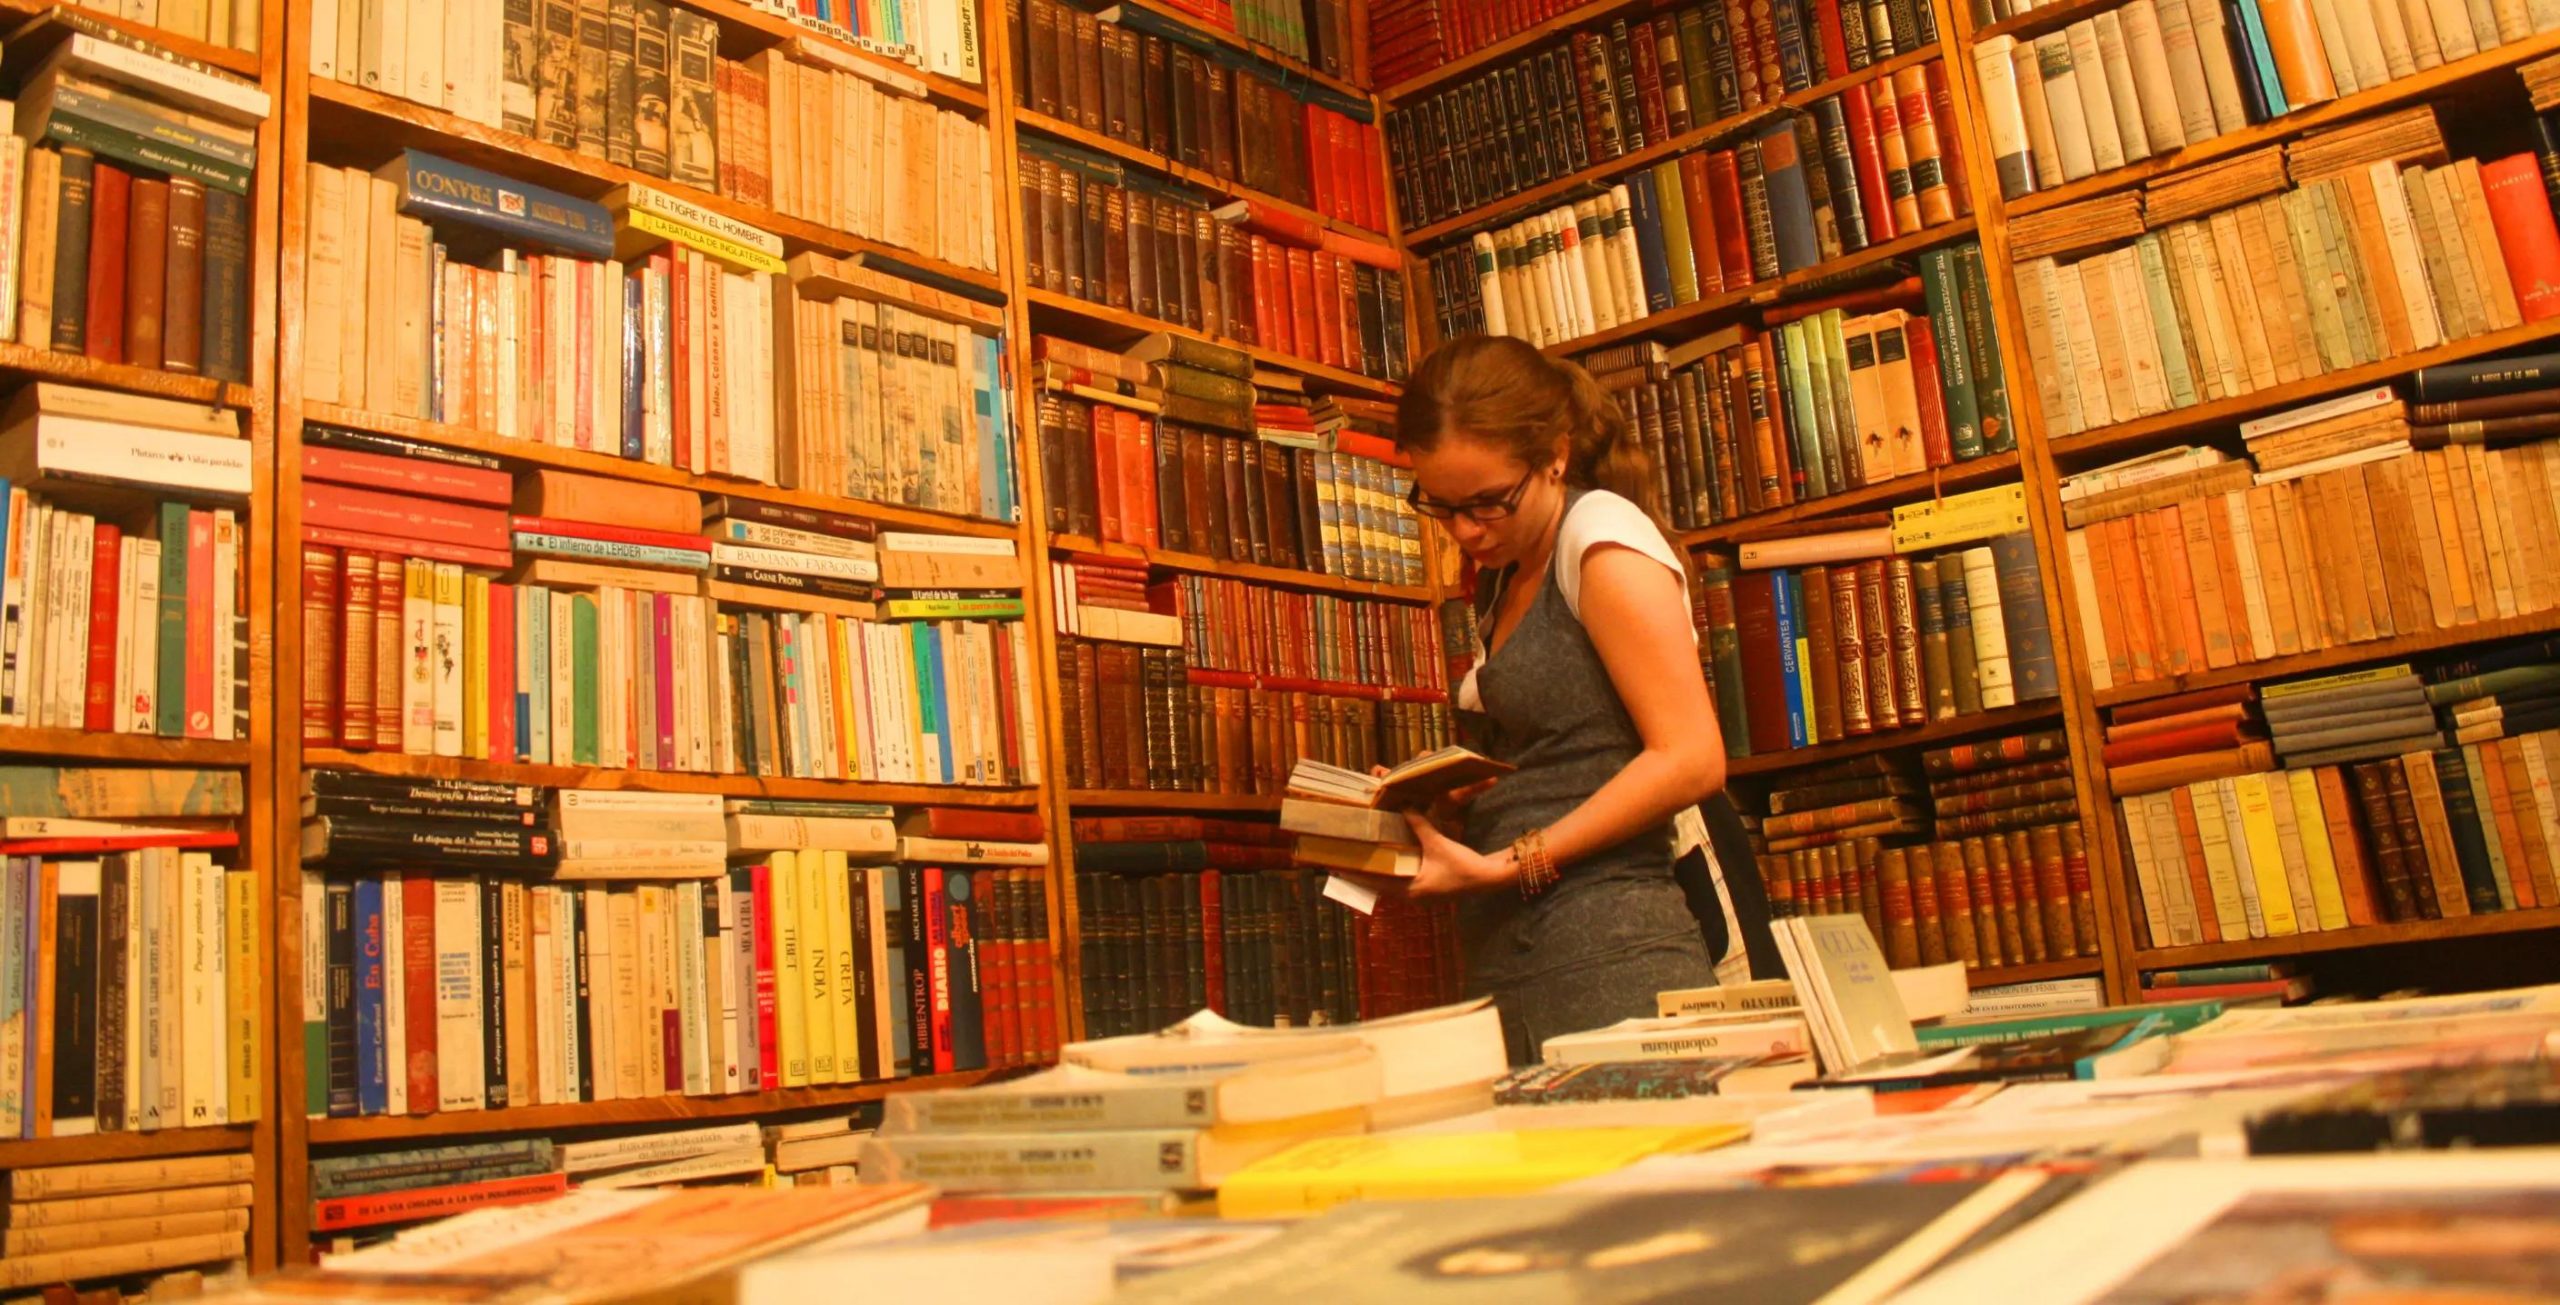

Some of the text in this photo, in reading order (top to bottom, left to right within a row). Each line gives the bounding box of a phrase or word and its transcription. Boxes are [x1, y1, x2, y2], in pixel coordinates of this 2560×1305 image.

[963, 7, 976, 67] EL COMPLOT
[416, 169, 495, 210] FRANCO
[655, 195, 764, 246] EL TIGRE Y EL HOMBRE
[655, 220, 772, 268] LA BATALLA DE INGLATERRA
[559, 539, 590, 553] infierno
[592, 541, 604, 553] de
[606, 543, 641, 558] LEHDER
[737, 549, 799, 569] BAUMANN
[1780, 619, 1795, 673] CERVANTES
[410, 788, 464, 802] Demografía
[413, 834, 422, 843] La
[454, 836, 466, 845] del
[494, 838, 520, 847] Mundo
[739, 899, 751, 928] CUBA
[911, 897, 921, 941] MICHAEL
[364, 913, 380, 958] Cuba
[740, 930, 752, 953] MEA
[1820, 930, 1871, 955] CELA
[365, 964, 380, 989] En
[812, 949, 826, 1000] INDIA
[840, 950, 853, 1007] CRETA
[935, 948, 948, 1011] DIARIO
[969, 938, 978, 993] memorias
[914, 968, 929, 1050] RIBBENTROP
[1641, 1037, 1718, 1053] colombiana
[373, 1205, 385, 1214] LA
[449, 1196, 455, 1205] A
[457, 1195, 467, 1204] LA
